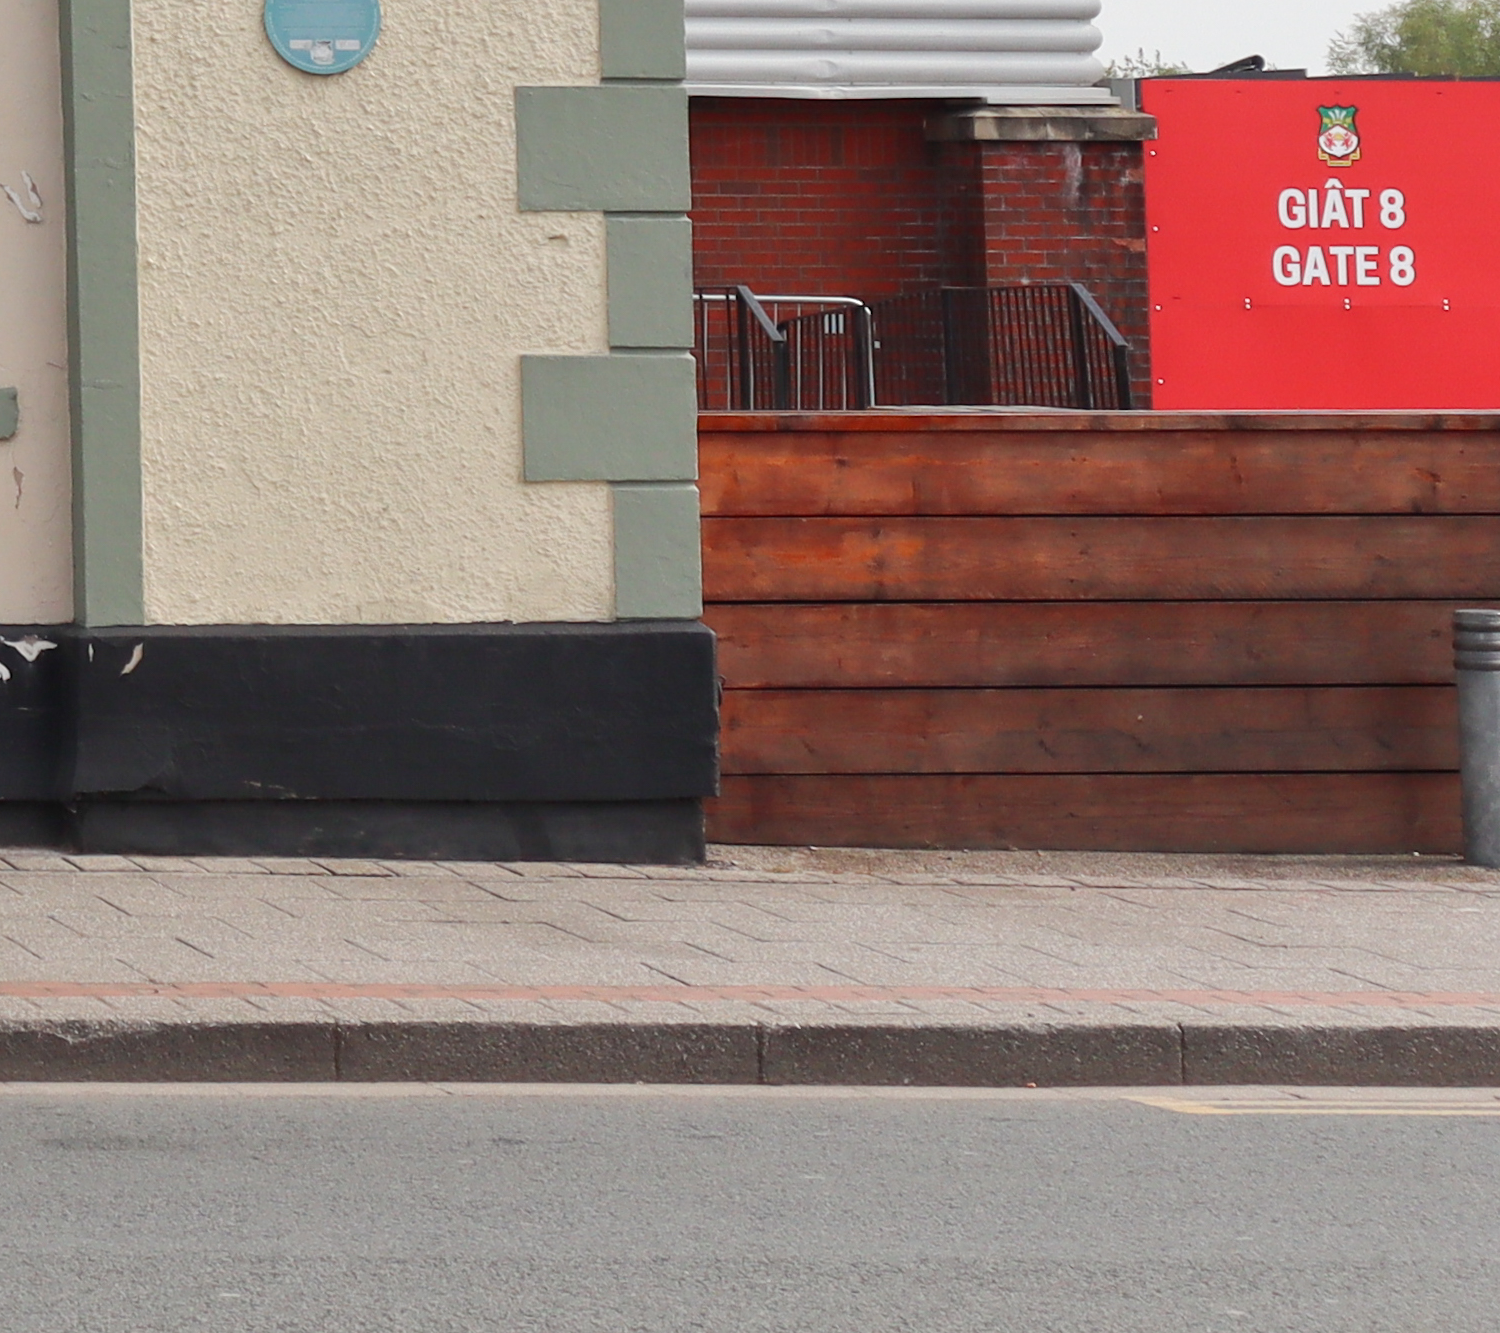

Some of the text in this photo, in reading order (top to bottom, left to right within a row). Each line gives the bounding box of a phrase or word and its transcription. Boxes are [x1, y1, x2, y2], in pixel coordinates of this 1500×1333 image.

[1277, 177, 1407, 229] GIÂT 8
[1272, 245, 1417, 286] GATE 8
